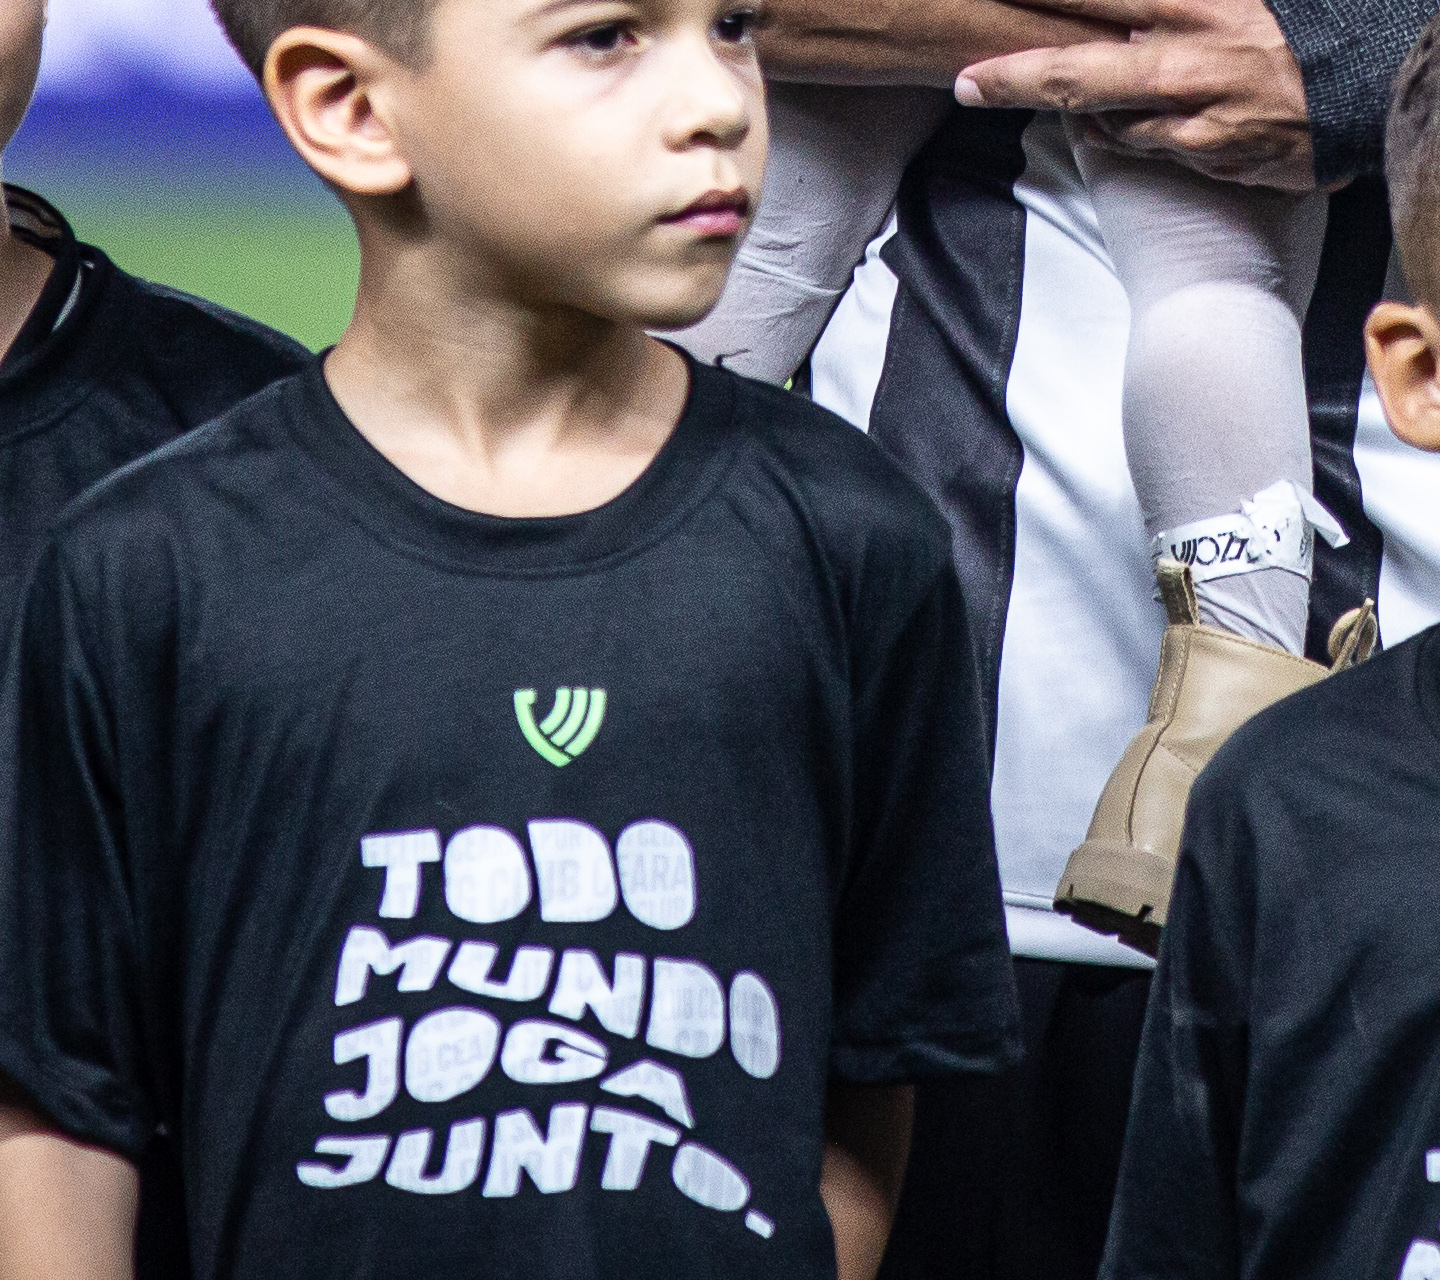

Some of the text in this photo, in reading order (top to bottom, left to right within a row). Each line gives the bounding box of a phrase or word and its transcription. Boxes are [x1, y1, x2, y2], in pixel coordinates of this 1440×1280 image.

[359, 816, 698, 932] TODO
[323, 1004, 696, 1130] JOGA
[333, 922, 781, 1080] MUNDO
[295, 1101, 775, 1240] JUNTO.
